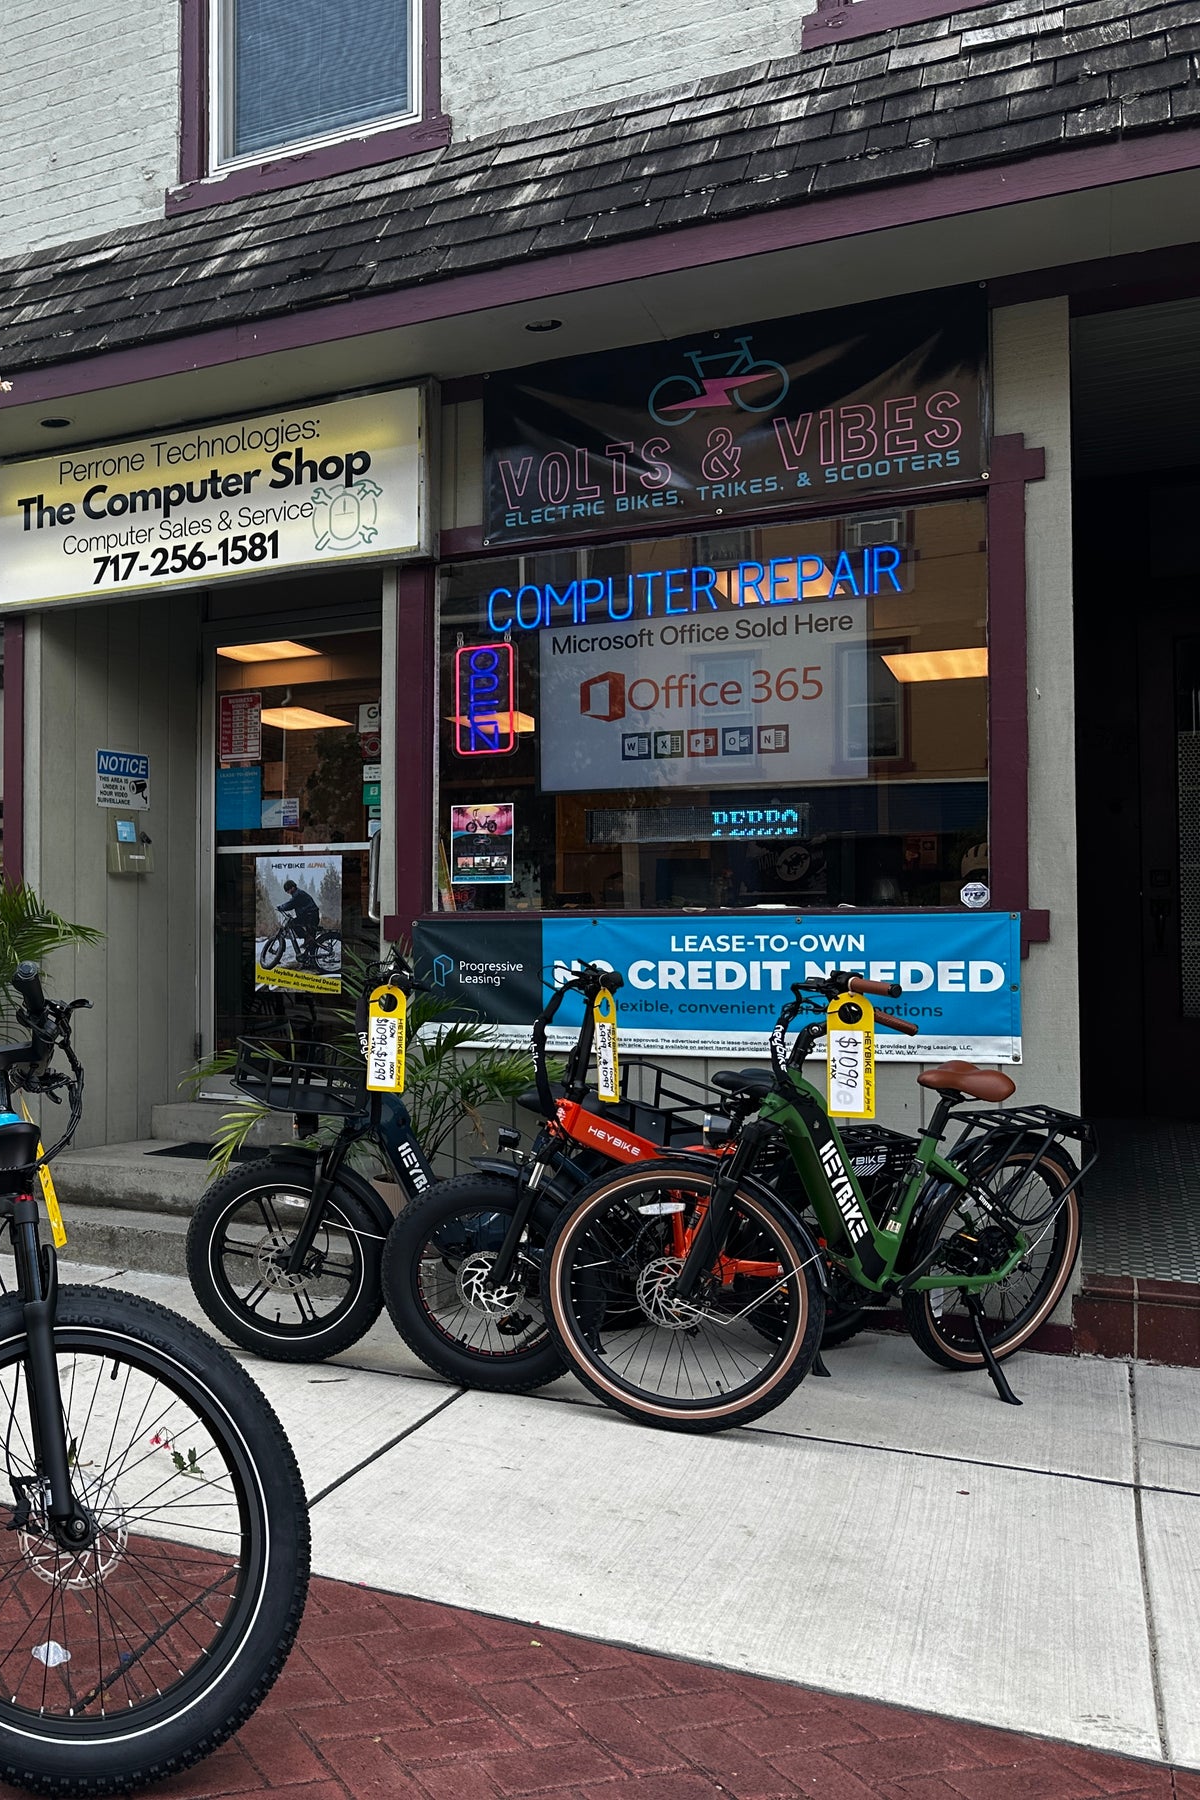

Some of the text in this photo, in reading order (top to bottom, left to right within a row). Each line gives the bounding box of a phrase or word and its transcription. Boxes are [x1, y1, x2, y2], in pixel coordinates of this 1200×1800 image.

[59, 418, 321, 485] Perrone Technologies:
[499, 390, 962, 510] VOLTS & VIBES
[17, 447, 372, 532] The Computer Shop
[504, 449, 961, 528] ELECTRIC BIKES, TRIKES, & SCOOTERS
[62, 499, 314, 557] Computer Sales & Service
[93, 530, 280, 585] 717-256-1581
[488, 545, 903, 632] COMPUTER REPAIR
[551, 611, 854, 656] Microsoft Office Sold Here
[469, 648, 499, 751] OPEN
[627, 665, 824, 712] Office 365
[98, 754, 148, 775] NOTICE
[110, 776, 124, 784] AREA
[97, 797, 131, 805] SURVEILLANCE
[670, 934, 865, 953] LEASE-TO-OWN
[294, 972, 323, 984] Authorized
[322, 978, 340, 987] Dealer
[459, 960, 524, 973] Progressive
[459, 974, 502, 986] Leasing
[628, 960, 790, 991] CREDIT
[678, 1001, 776, 1016] convenient
[772, 1024, 788, 1072] heybike
[835, 1036, 862, 1089] $1099
[864, 1031, 872, 1074] HEYBIKE
[588, 1125, 641, 1156] HEYBIKE
[848, 1154, 887, 1166] YBIKE
[57, 1314, 165, 1347] CHAO YANG
